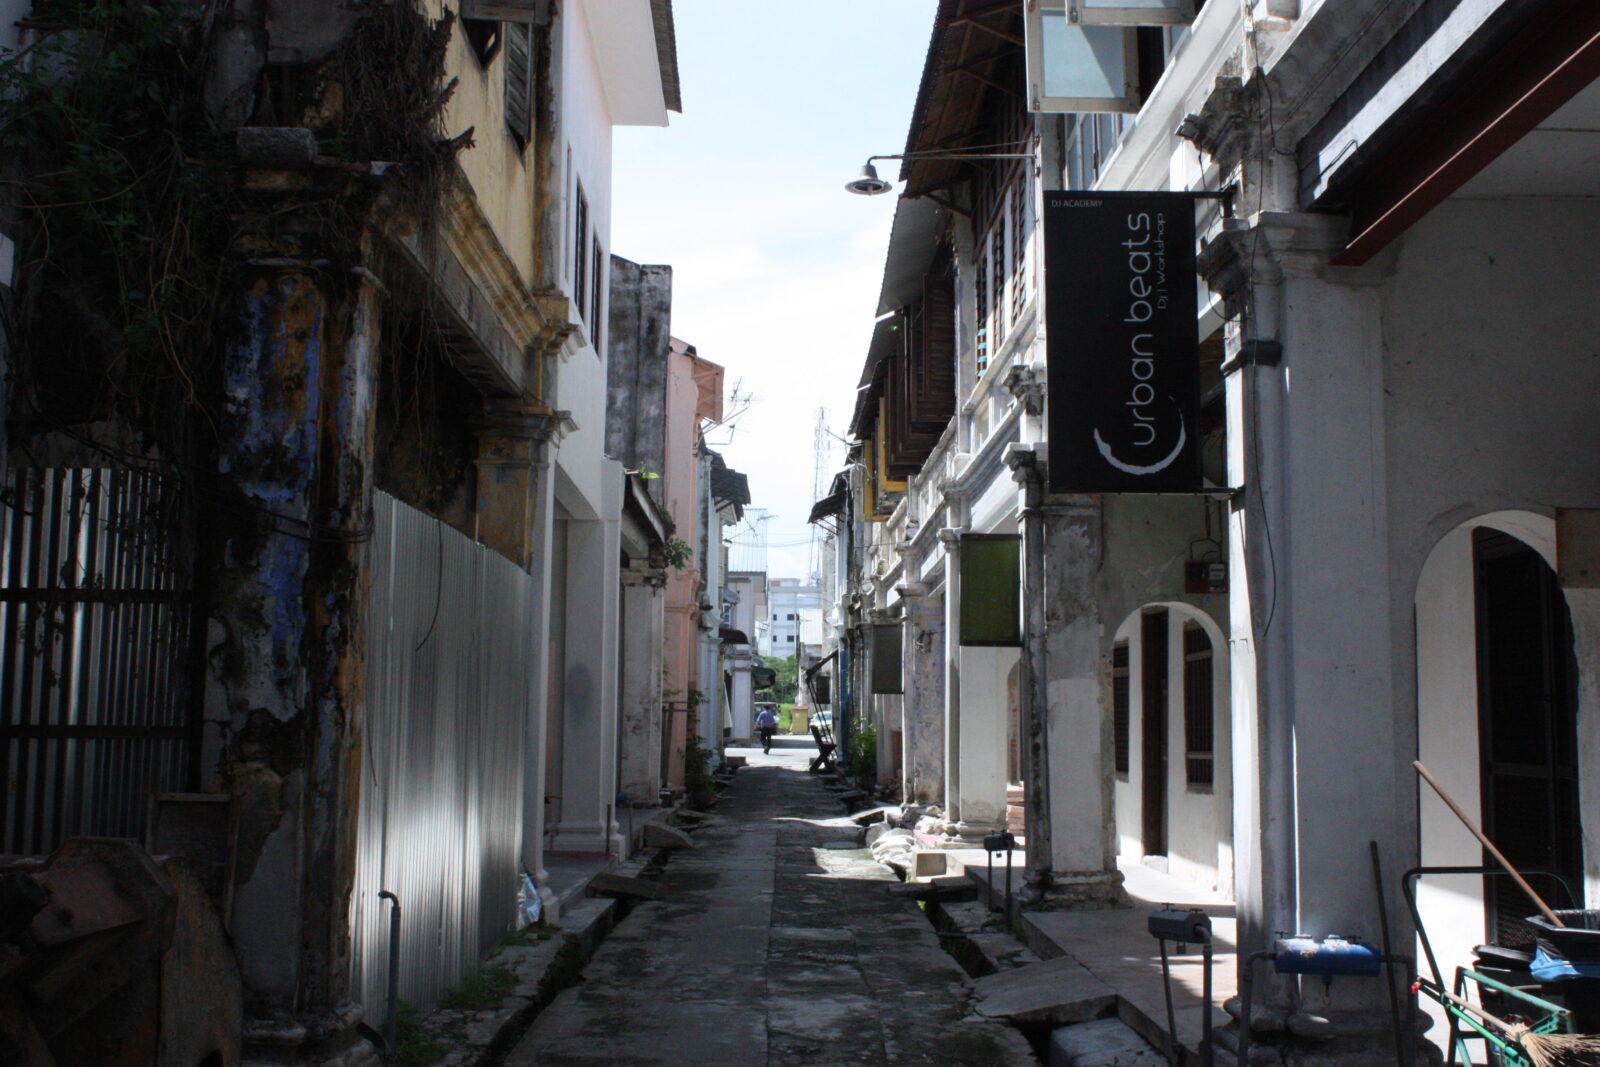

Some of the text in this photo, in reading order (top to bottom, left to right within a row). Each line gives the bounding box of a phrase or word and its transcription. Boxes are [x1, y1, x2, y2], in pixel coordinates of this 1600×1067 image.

[1051, 199, 1103, 208] DJ ACADEMY
[1153, 212, 1166, 285] Workshop
[1121, 212, 1156, 446] urban beats
